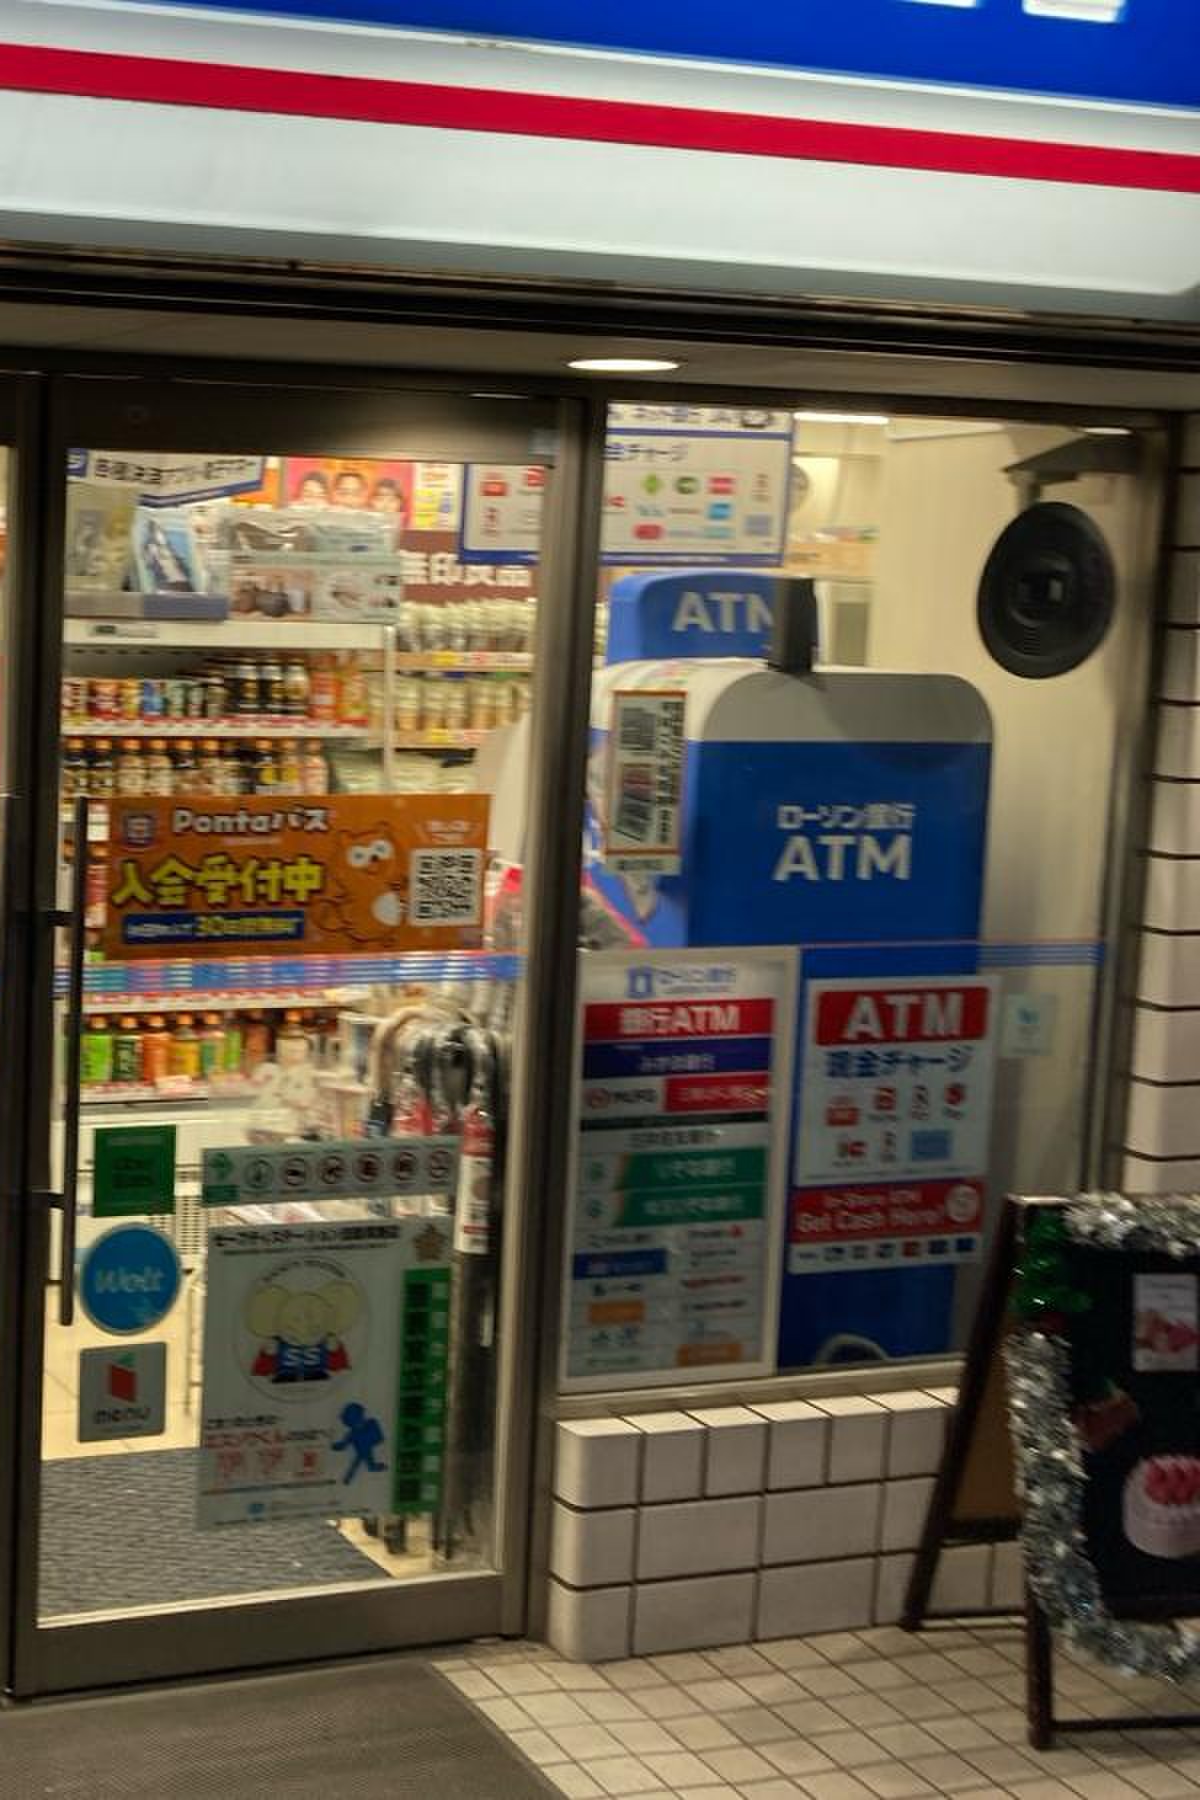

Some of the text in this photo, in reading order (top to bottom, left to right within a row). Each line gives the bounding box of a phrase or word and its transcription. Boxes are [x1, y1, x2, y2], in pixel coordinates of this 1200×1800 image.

[777, 802, 917, 830] ローソン銀行
[772, 834, 913, 882] ATM
[845, 992, 965, 1041] ATM
